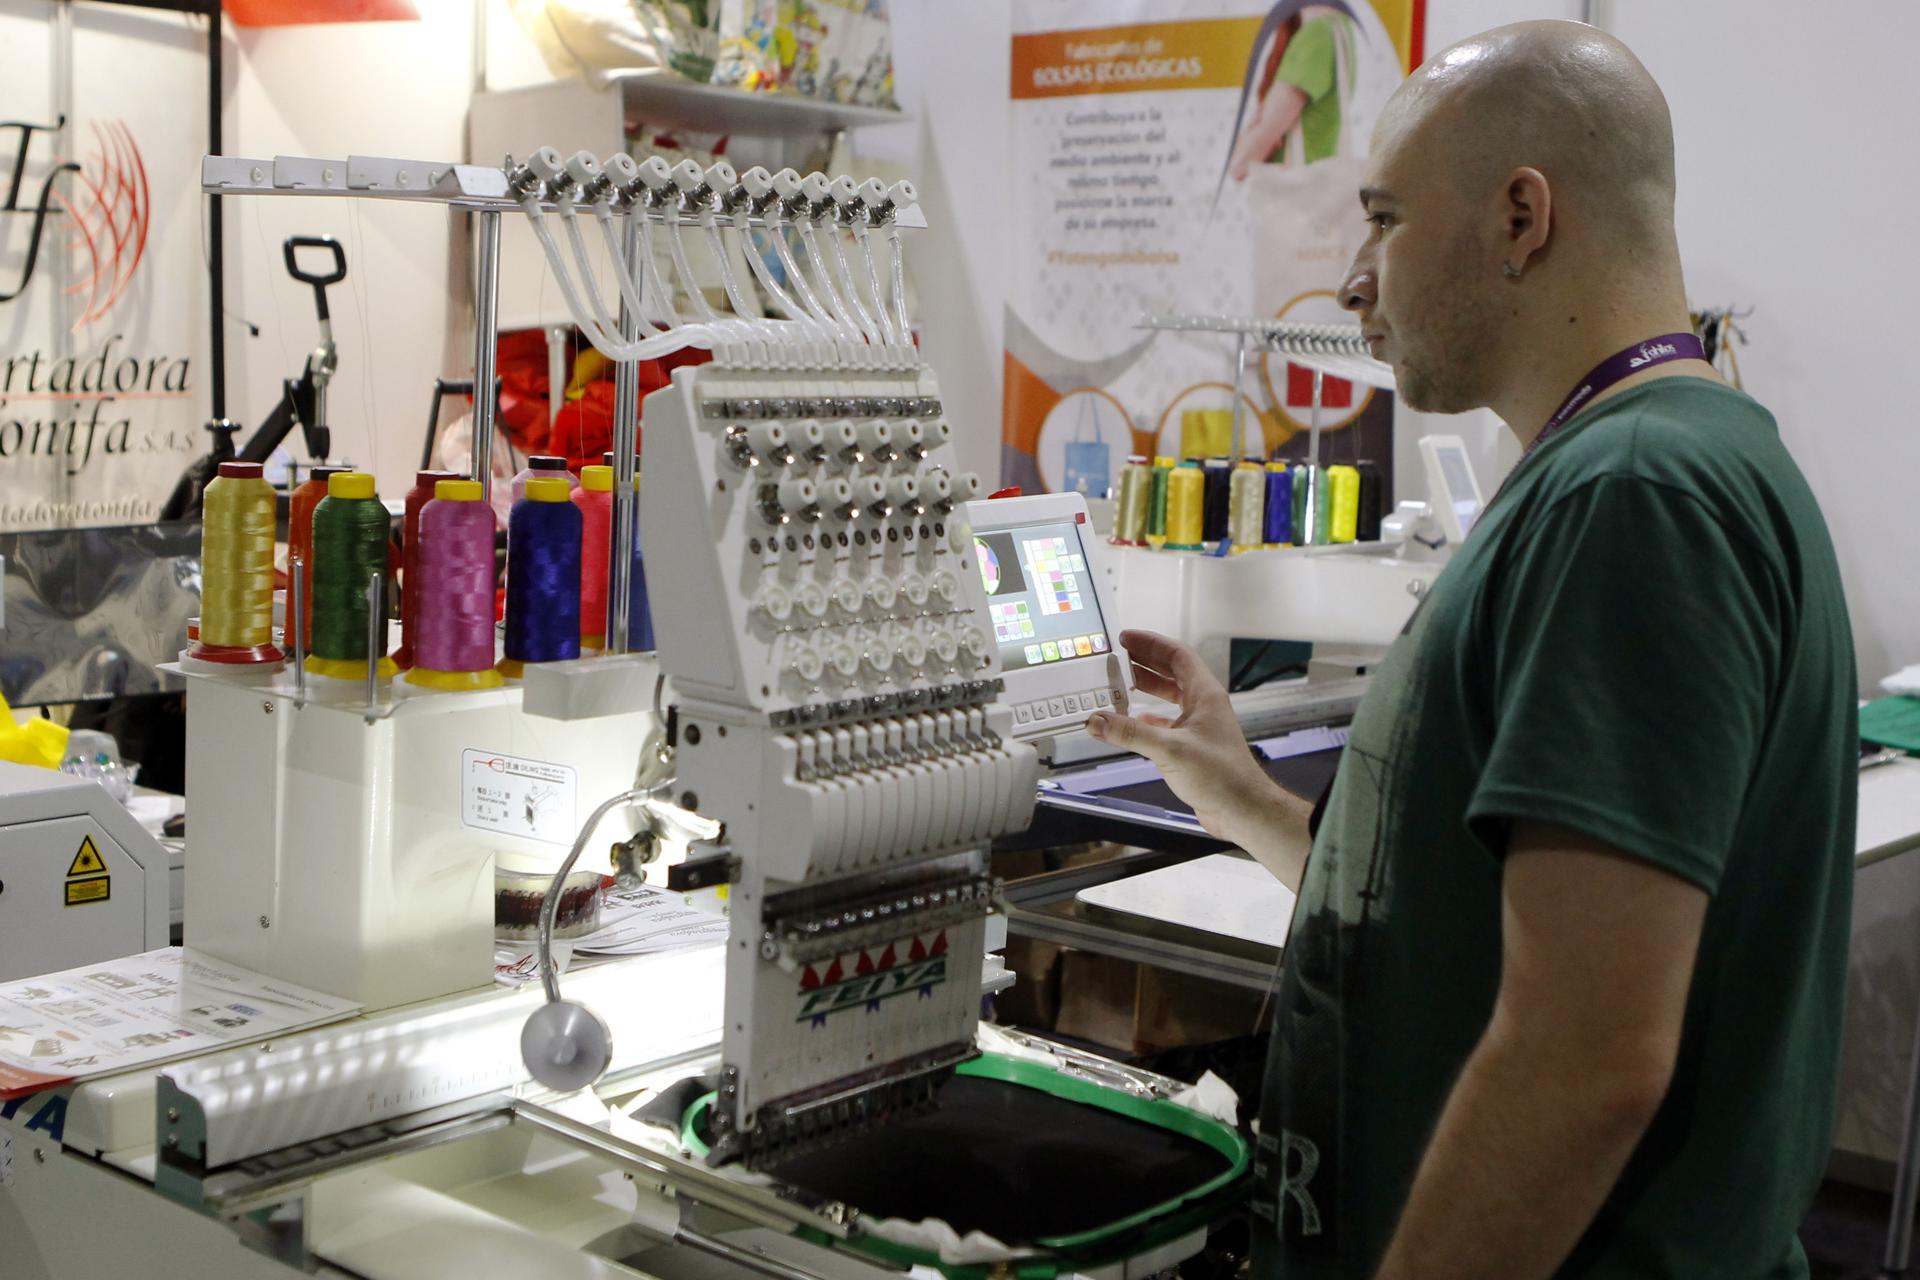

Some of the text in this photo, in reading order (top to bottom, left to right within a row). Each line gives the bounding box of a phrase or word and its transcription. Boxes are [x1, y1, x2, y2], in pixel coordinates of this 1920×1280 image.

[1033, 56, 1203, 87] BOLSAS ECOLÓGICAS
[1132, 195, 1173, 208] marca
[0, 397, 131, 476] onifa
